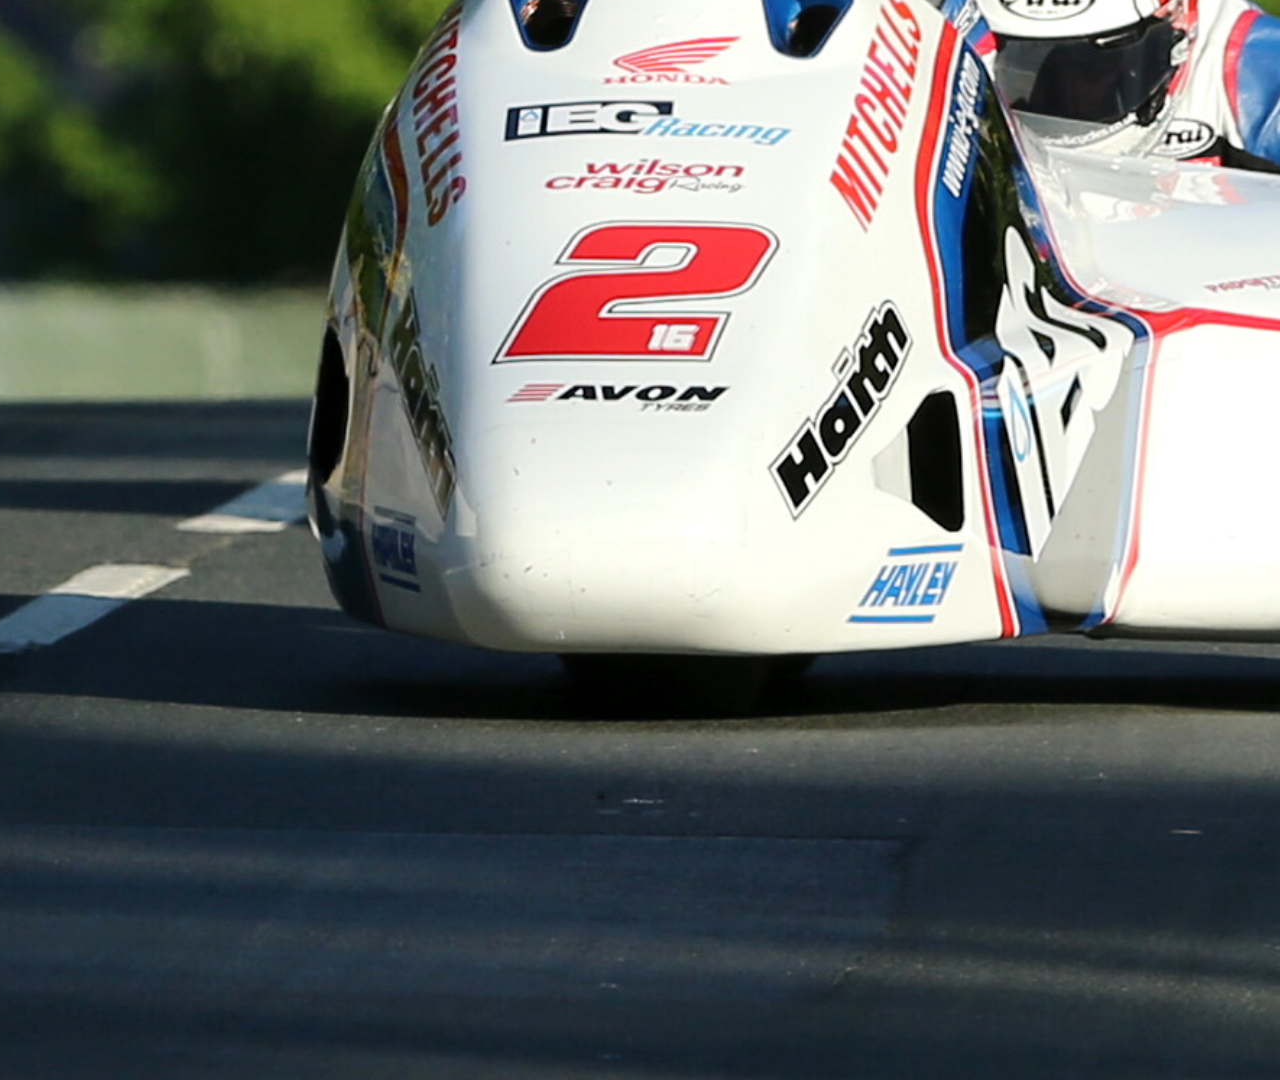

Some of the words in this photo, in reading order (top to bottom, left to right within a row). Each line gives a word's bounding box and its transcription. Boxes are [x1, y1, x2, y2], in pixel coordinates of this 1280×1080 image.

[603, 72, 732, 86] HONDA
[641, 116, 791, 145] Racing
[585, 159, 745, 178] wilson
[544, 175, 670, 195] craig
[496, 222, 777, 363] 2
[647, 324, 698, 351] 16
[556, 384, 730, 402] AVON
[640, 403, 712, 412] TYRES
[771, 302, 911, 517] Haith
[858, 562, 958, 608] HAYLEY
